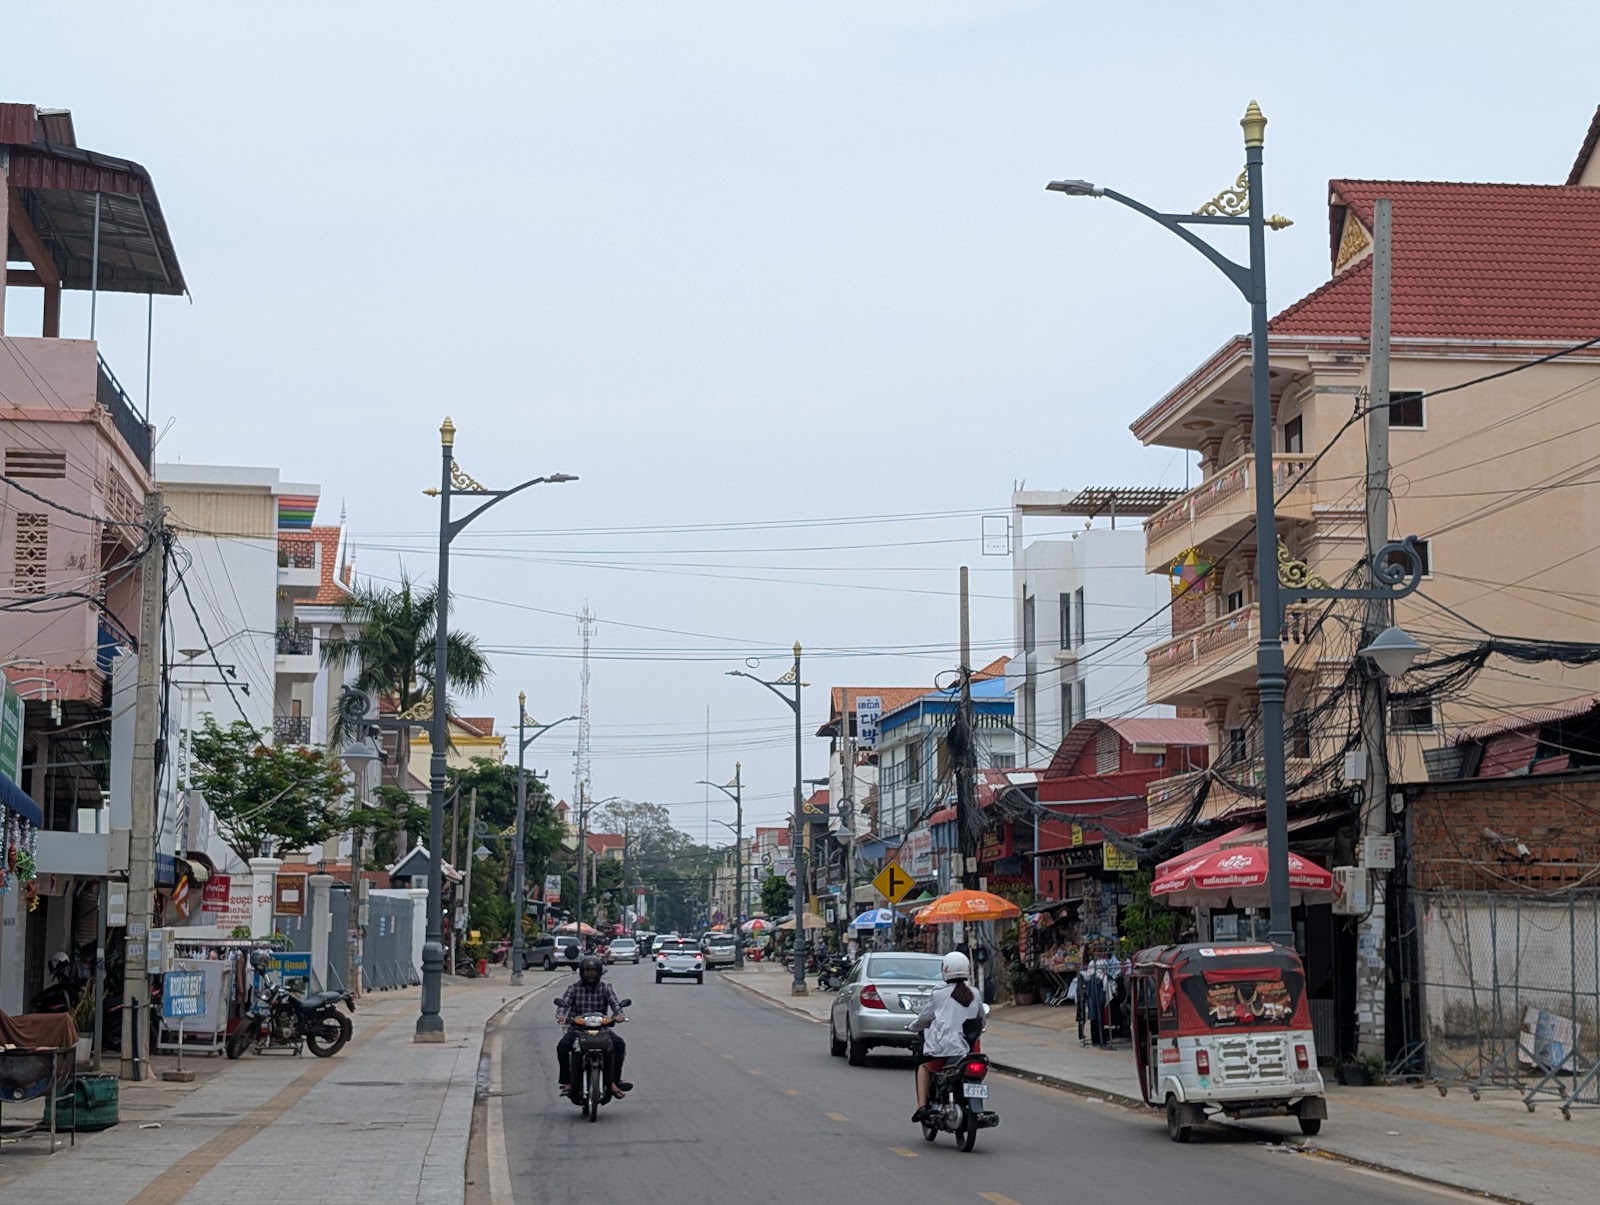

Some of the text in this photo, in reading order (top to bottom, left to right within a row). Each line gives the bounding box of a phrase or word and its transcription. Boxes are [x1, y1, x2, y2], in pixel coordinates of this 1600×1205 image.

[170, 975, 202, 996] ROOM FOR RENT
